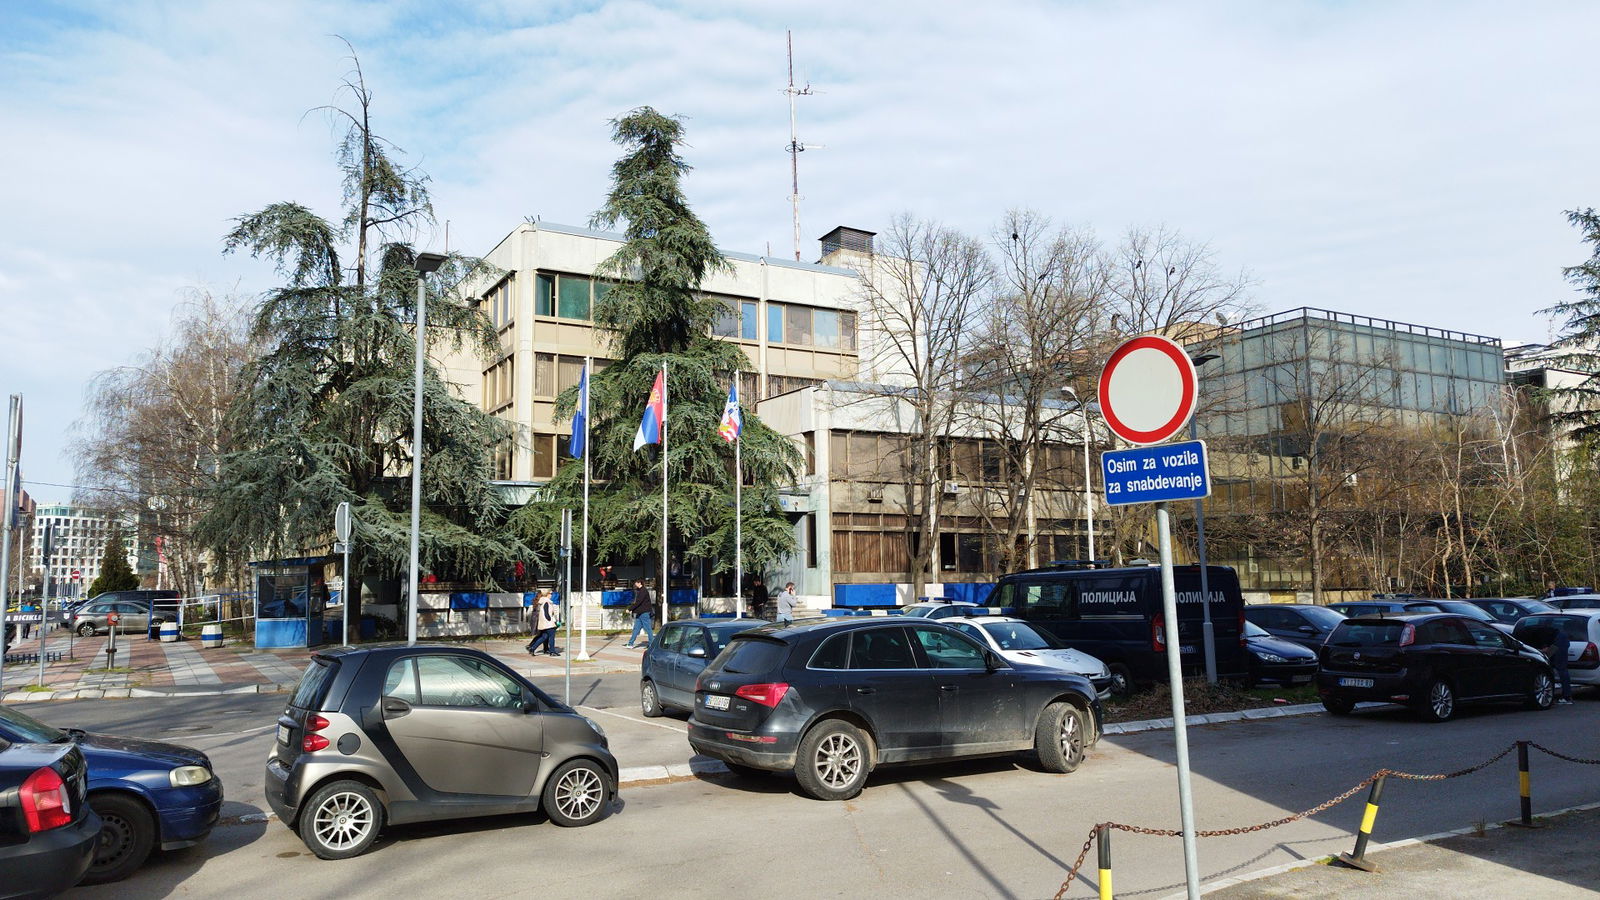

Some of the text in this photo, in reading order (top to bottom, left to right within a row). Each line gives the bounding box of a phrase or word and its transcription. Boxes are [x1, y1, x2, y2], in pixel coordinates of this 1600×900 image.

[1107, 450, 1199, 474] Osim za vozila
[1108, 472, 1203, 494] za snabdevanje
[1081, 590, 1137, 605] ПОЛИЦИЈА
[13, 614, 42, 622] BICIKLE
